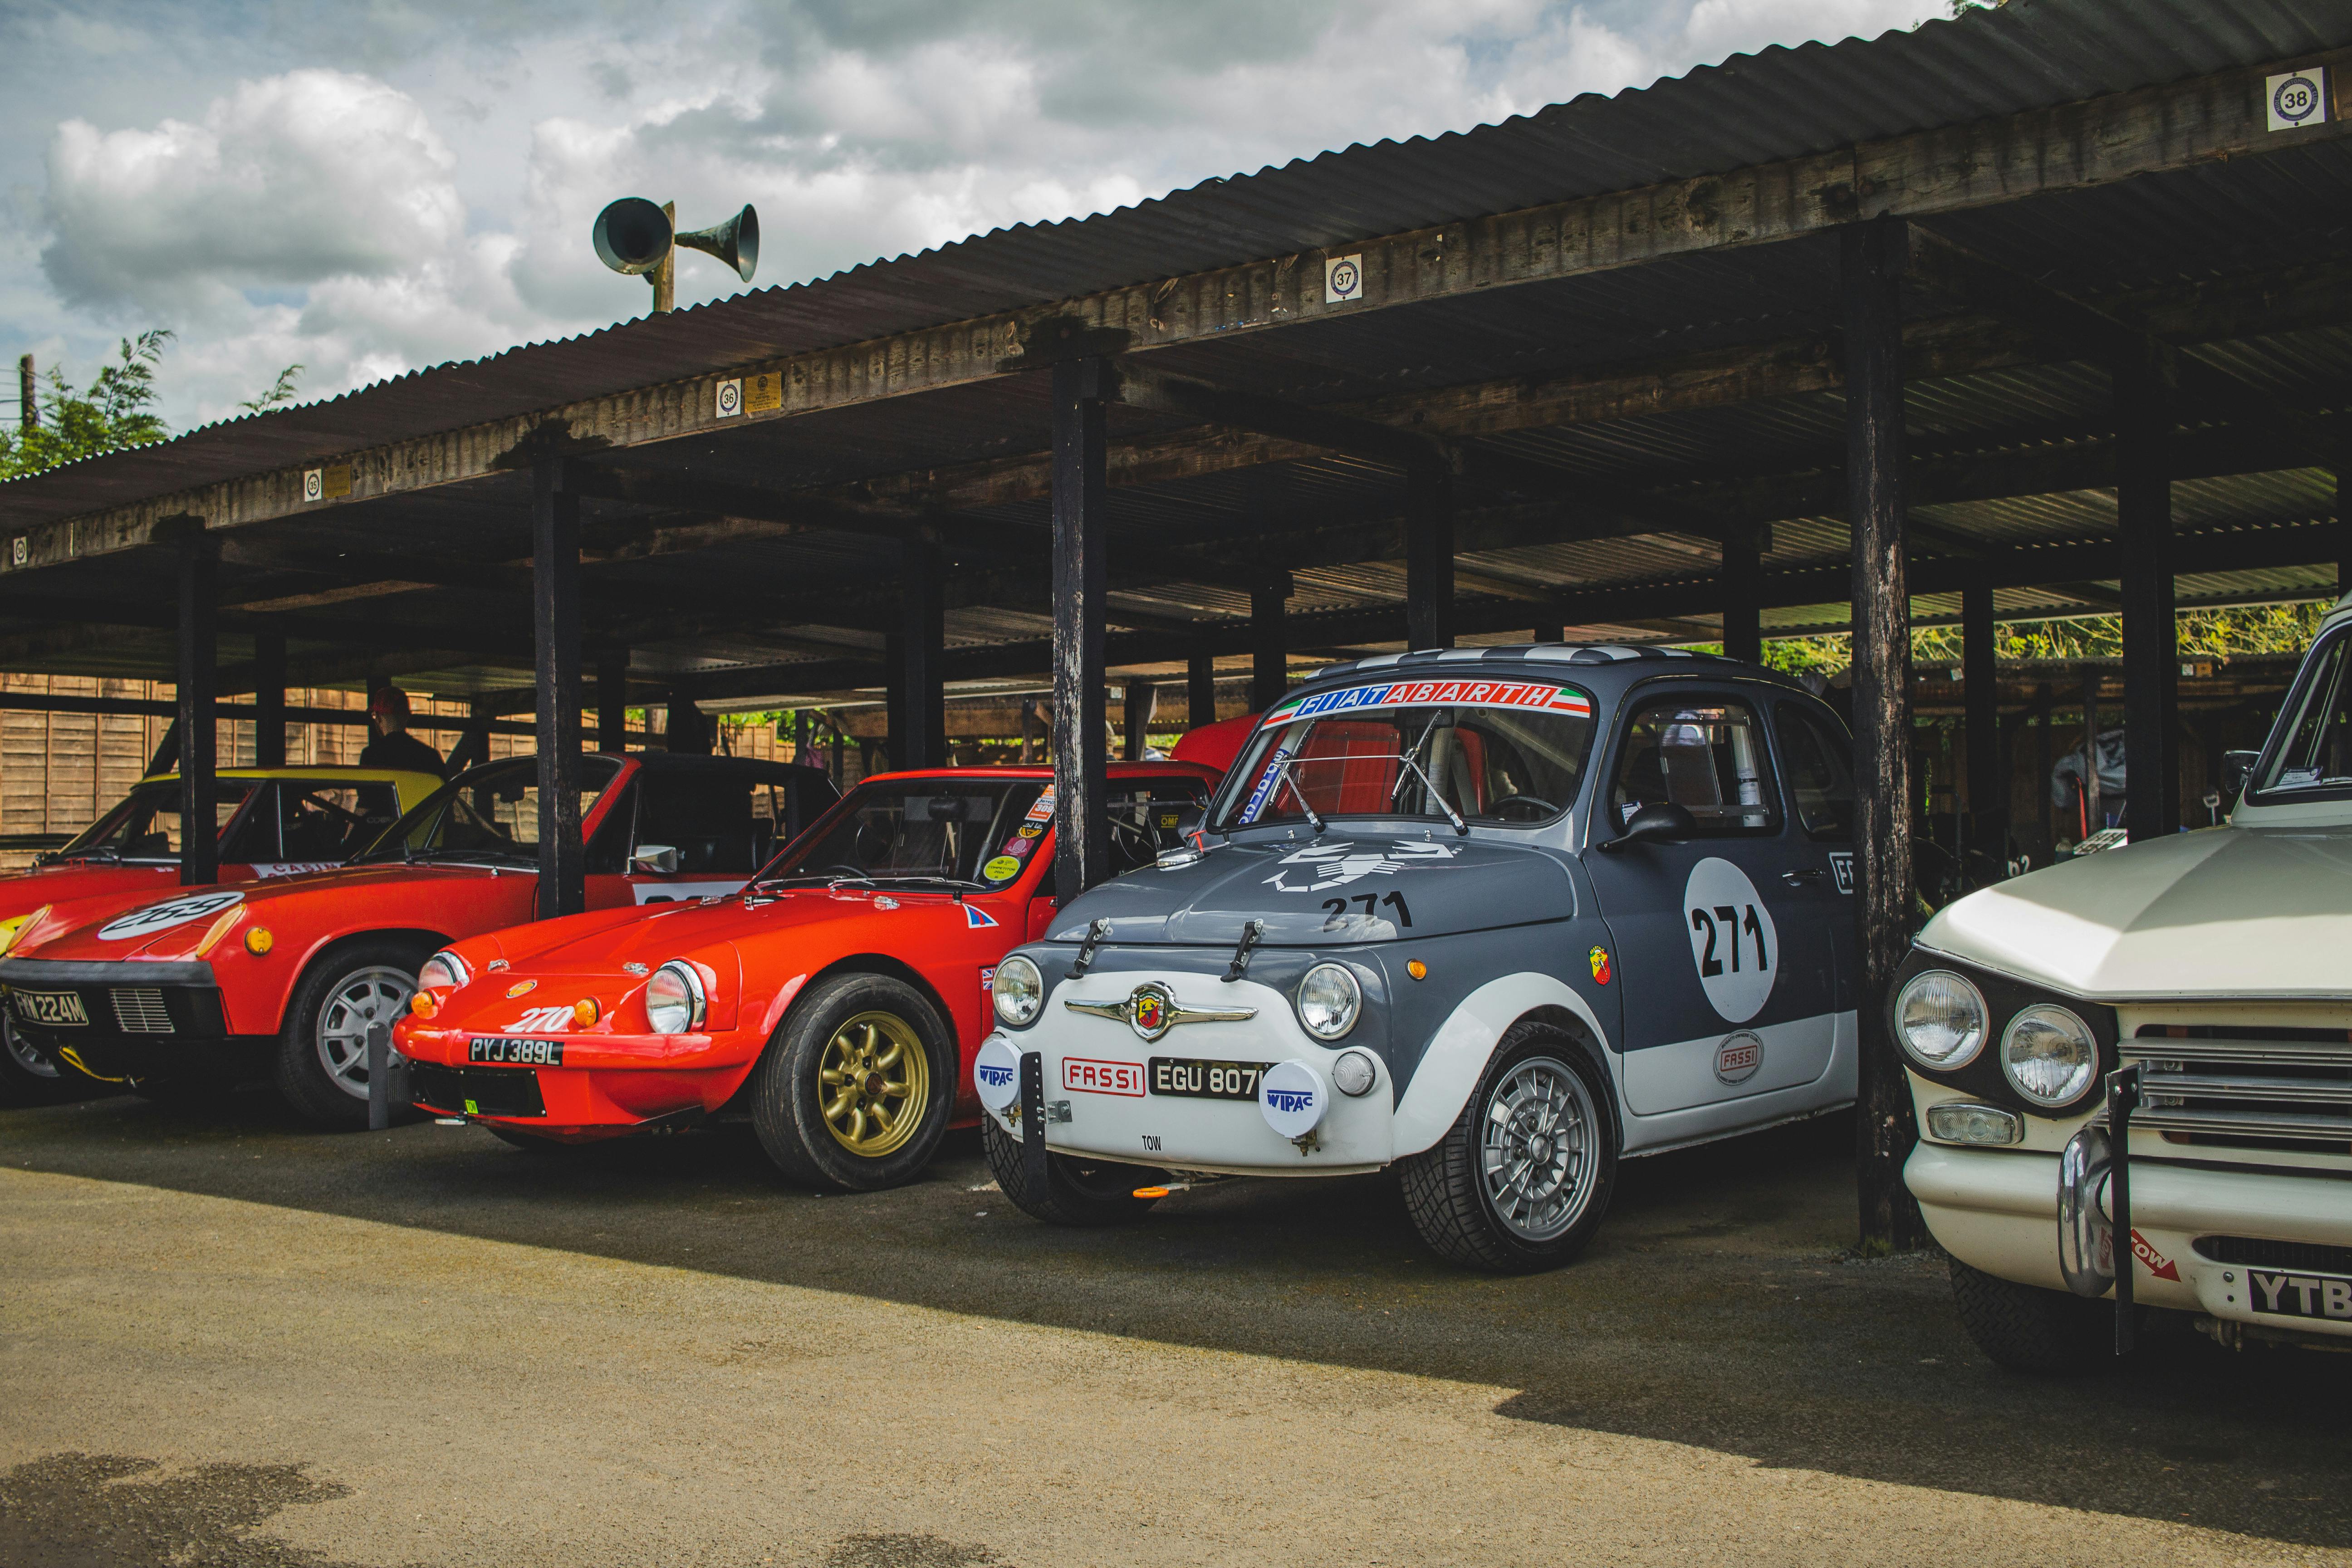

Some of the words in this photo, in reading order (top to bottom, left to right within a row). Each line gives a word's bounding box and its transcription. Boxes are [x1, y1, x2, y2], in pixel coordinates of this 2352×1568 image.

[2274, 88, 2284, 112] MIDLAND
[2283, 78, 2315, 91] AUTOMOBILE
[2284, 91, 2308, 109] 38
[1337, 272, 1352, 286] 37
[724, 393, 734, 404] 36
[310, 481, 317, 490] 35
[1301, 686, 1389, 715] FIAT
[1385, 683, 1553, 705] ABARTH
[1034, 804, 1054, 813] 309
[101, 896, 238, 933] 269
[1321, 891, 1413, 933] 271
[1691, 904, 1768, 978] 271
[35, 996, 86, 1021] 224M
[504, 1006, 575, 1033] 270
[471, 1039, 507, 1061] PYJ
[509, 1039, 560, 1065] 389L
[1724, 1050, 1754, 1067] FASSI
[979, 1068, 1014, 1086] WIPAC
[1069, 1064, 1137, 1090] FASSI
[1157, 1065, 1202, 1092] EGU
[467, 1101, 477, 1112] TOW
[1266, 1093, 1313, 1112] WIPAC
[1142, 1135, 1161, 1151] TOW
[2253, 1272, 2352, 1316] YTB
